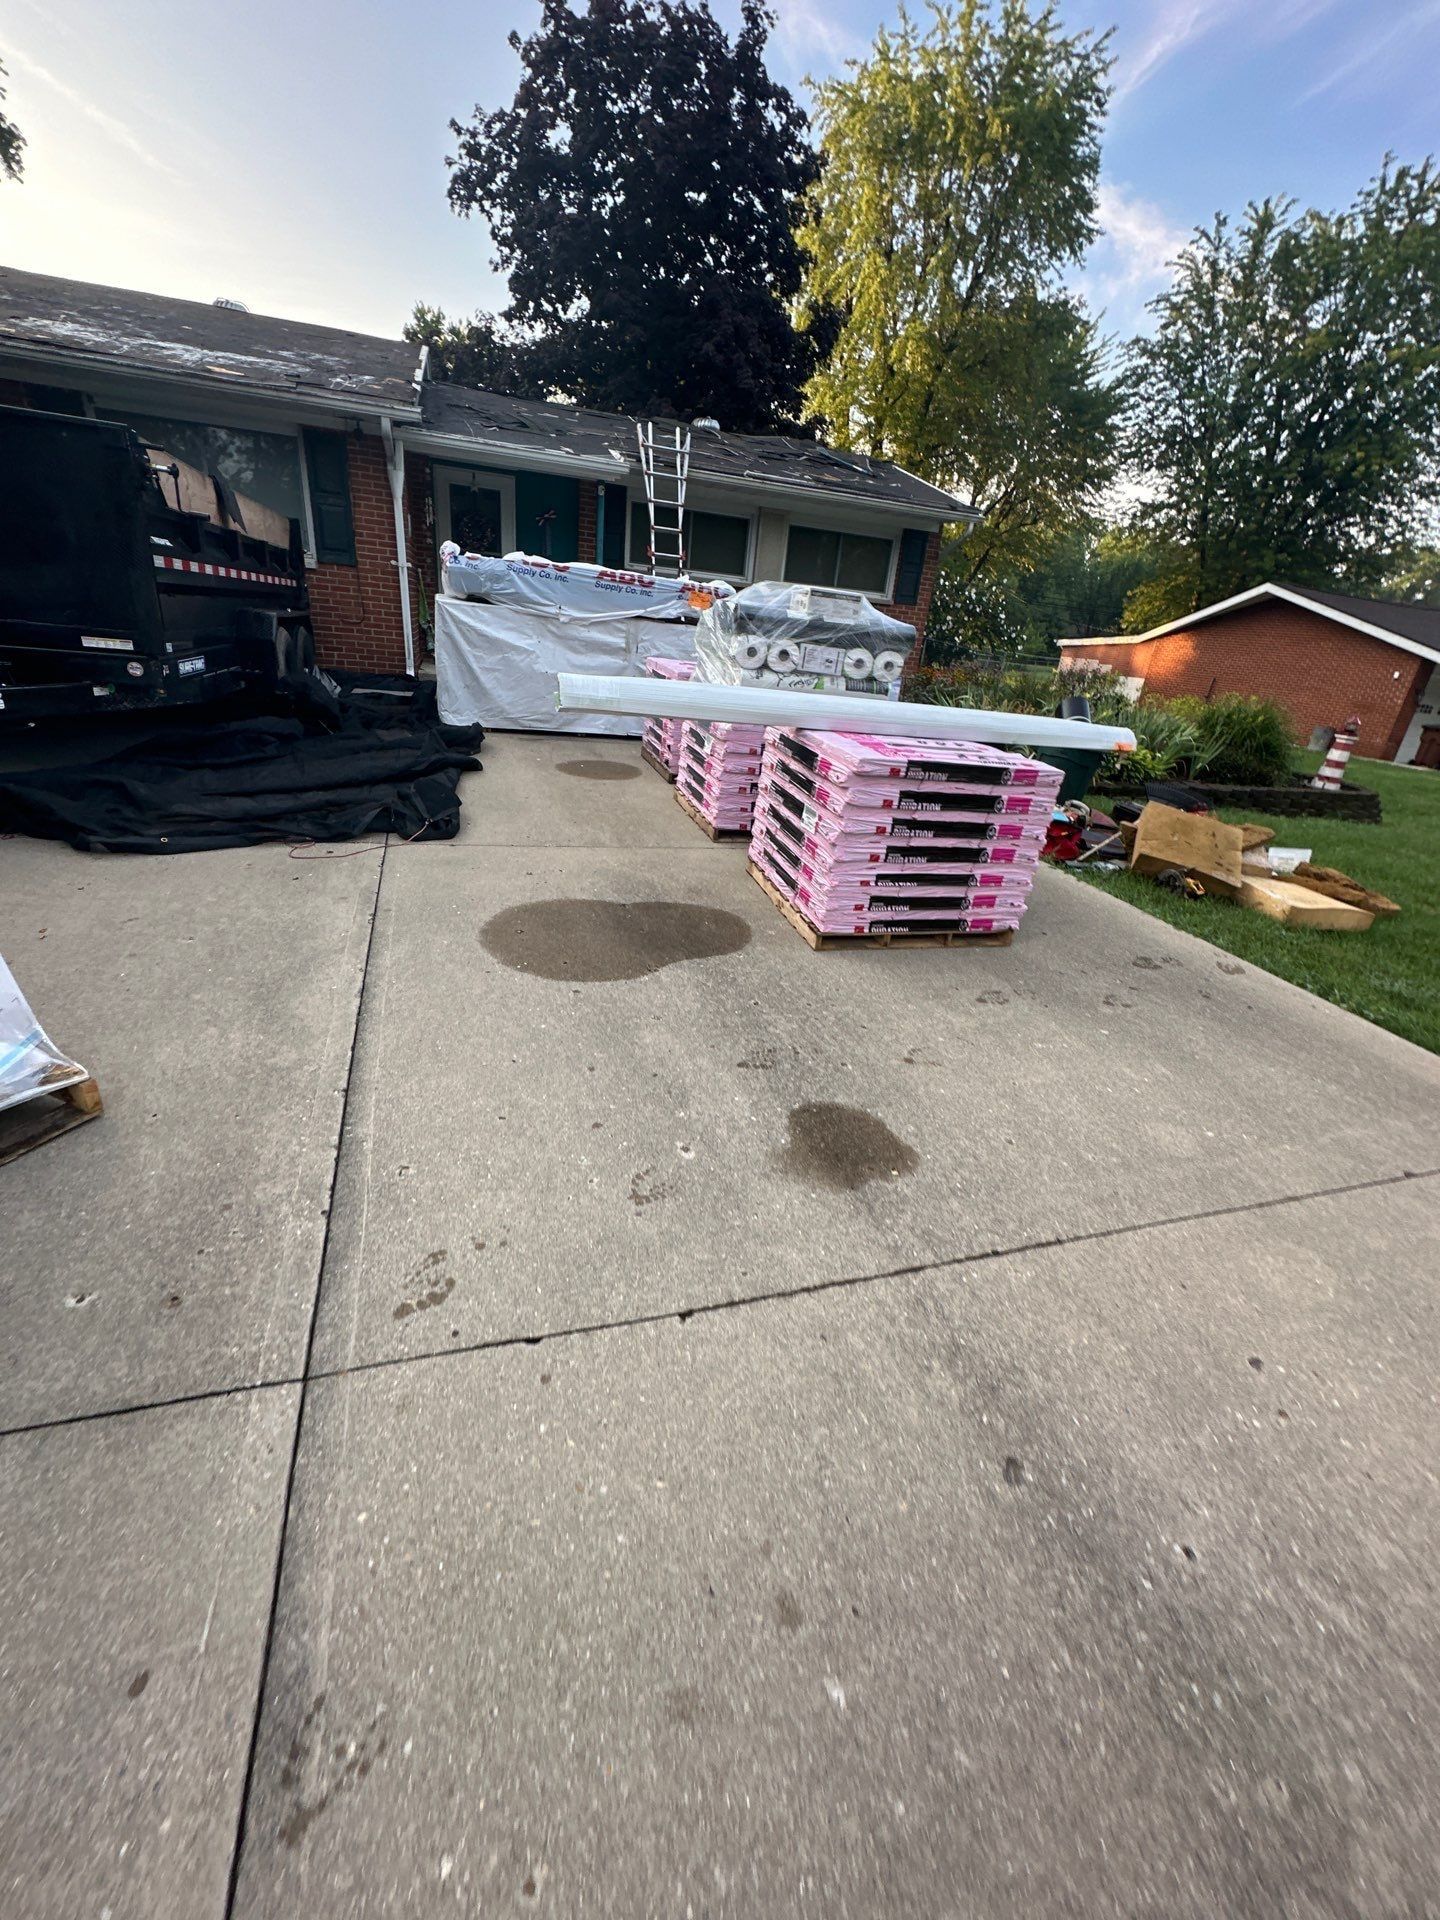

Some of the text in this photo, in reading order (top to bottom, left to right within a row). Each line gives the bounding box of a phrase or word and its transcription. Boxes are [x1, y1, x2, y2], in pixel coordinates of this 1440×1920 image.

[506, 564, 537, 577] Supply
[538, 569, 552, 580] Co.
[594, 581, 624, 594] Supply
[625, 585, 638, 595] Co.
